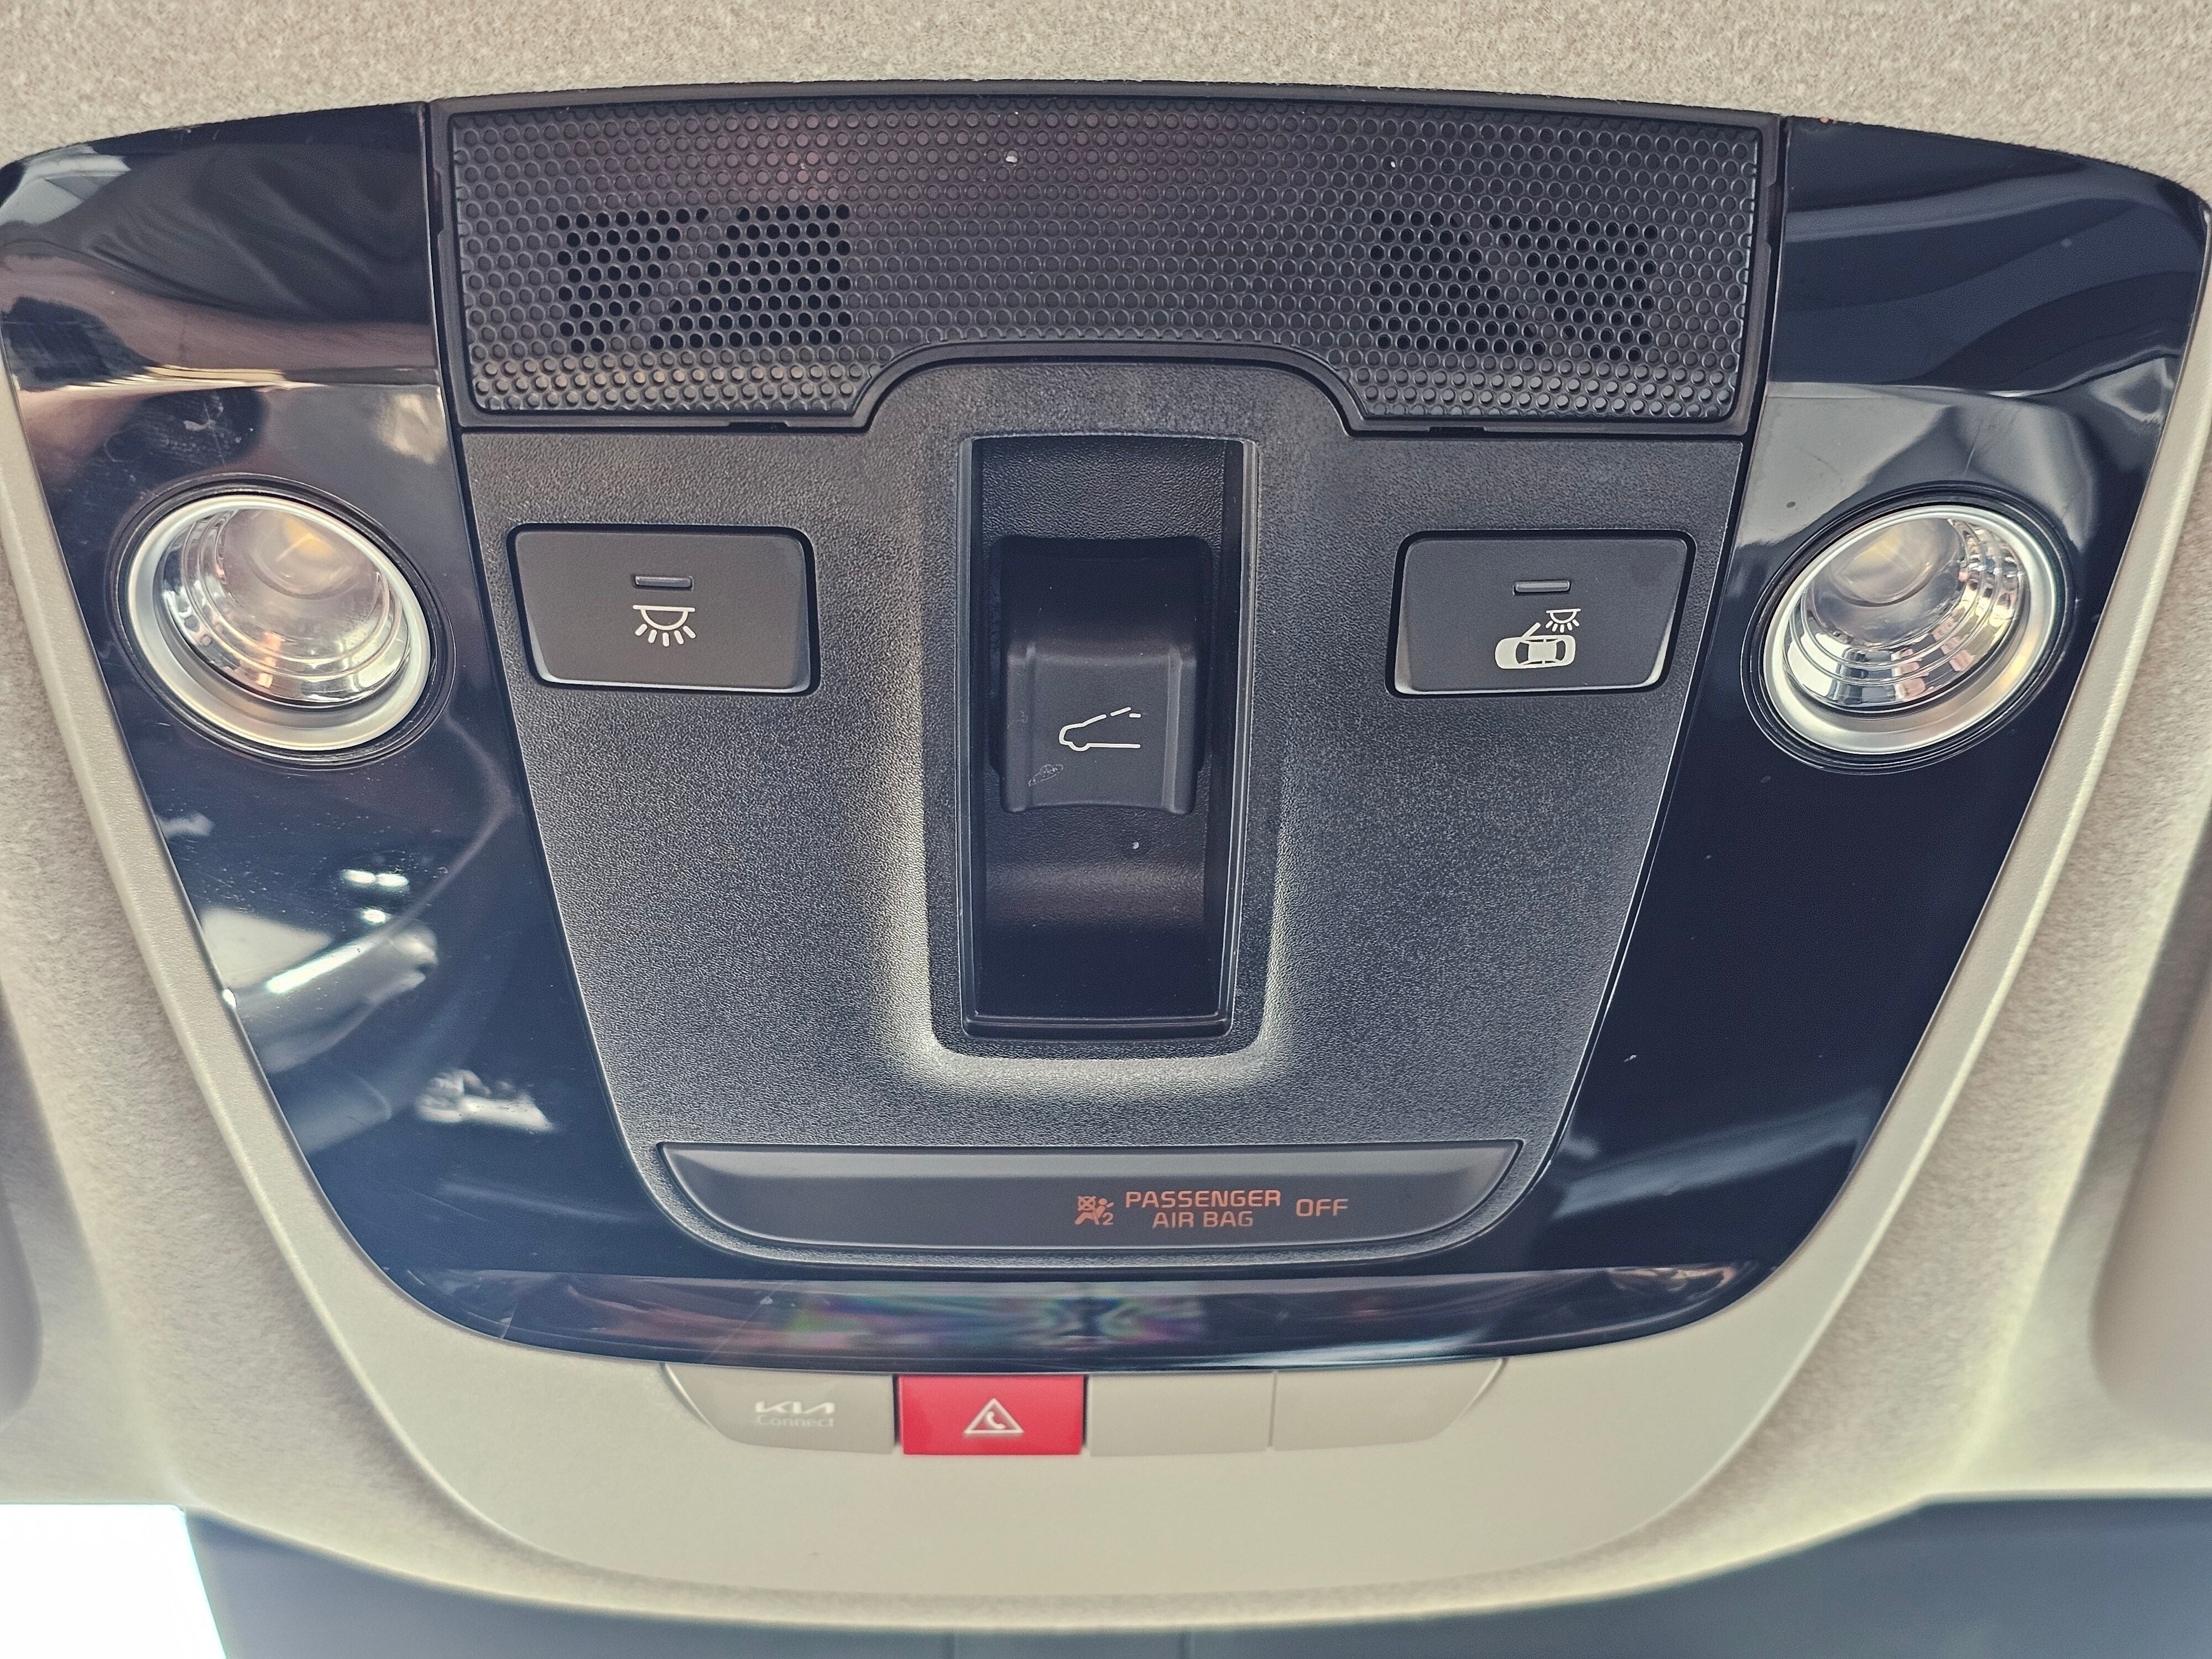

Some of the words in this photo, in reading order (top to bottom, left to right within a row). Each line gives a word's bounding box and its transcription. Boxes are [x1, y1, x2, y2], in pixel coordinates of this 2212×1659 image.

[1125, 1190, 1281, 1208] PASSENGER
[1296, 1198, 1349, 1217] OFF
[1152, 1212, 1194, 1229] AIR
[1202, 1211, 1254, 1228] BAG
[755, 1401, 835, 1414] KIA
[757, 1414, 834, 1427] Connect
